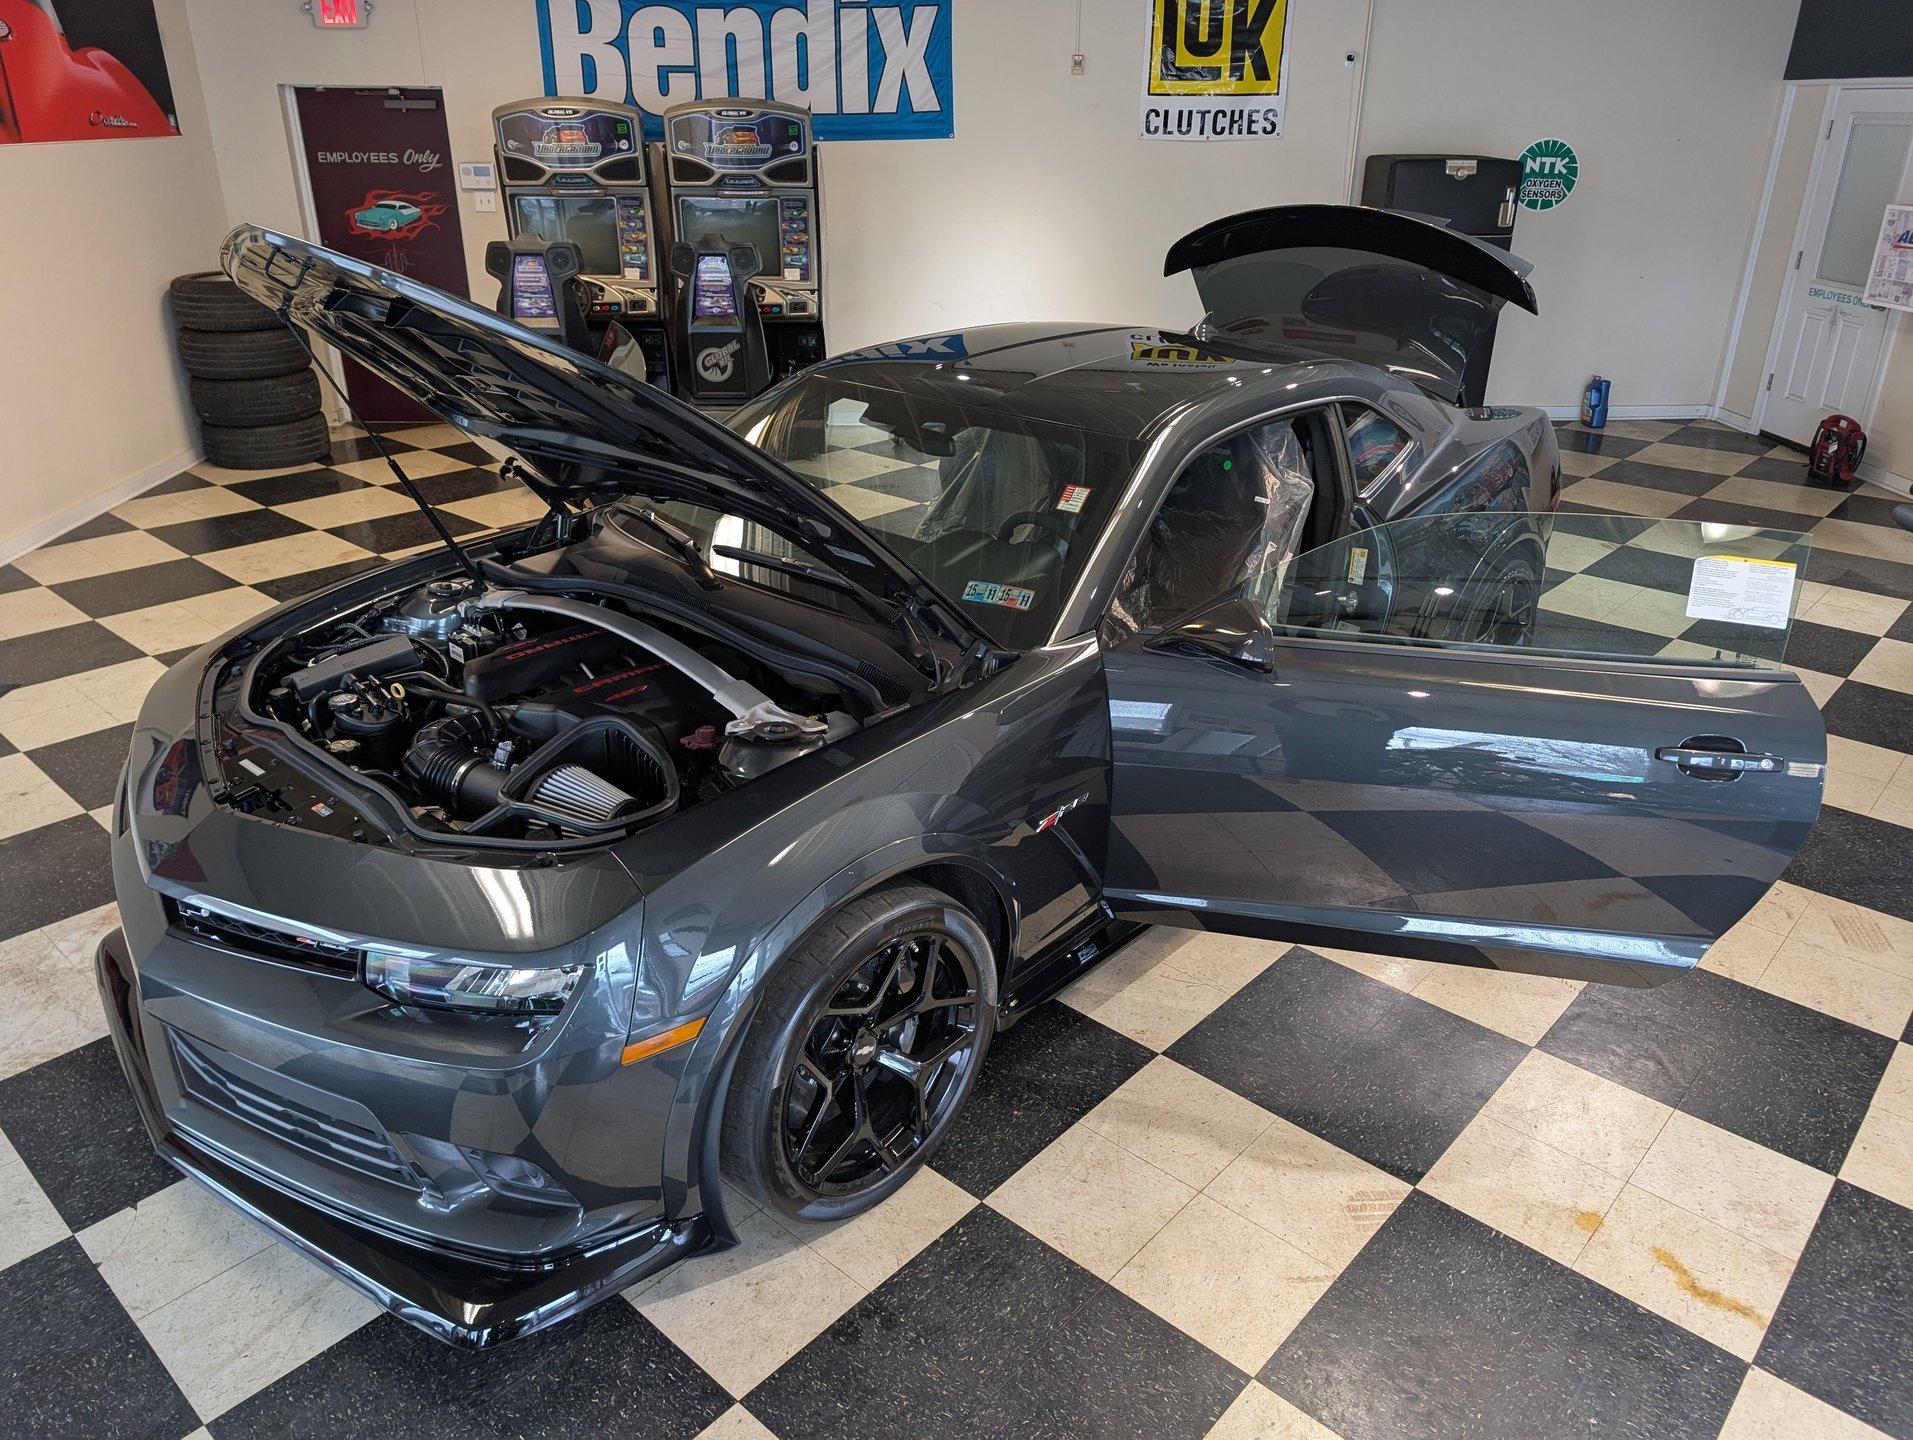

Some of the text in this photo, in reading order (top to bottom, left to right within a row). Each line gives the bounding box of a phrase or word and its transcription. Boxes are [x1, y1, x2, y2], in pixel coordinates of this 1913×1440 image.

[320, 0, 358, 24] EXIT
[547, 0, 943, 116] Bendix
[1144, 108, 1279, 136] CLUTCHES
[317, 149, 443, 173] EMPLOYEES Only
[1525, 156, 1570, 175] NTK
[1520, 189, 1563, 199] SENSORS
[1526, 179, 1562, 188] OXYGEN
[1808, 287, 1870, 308] EMPLOYEES ON
